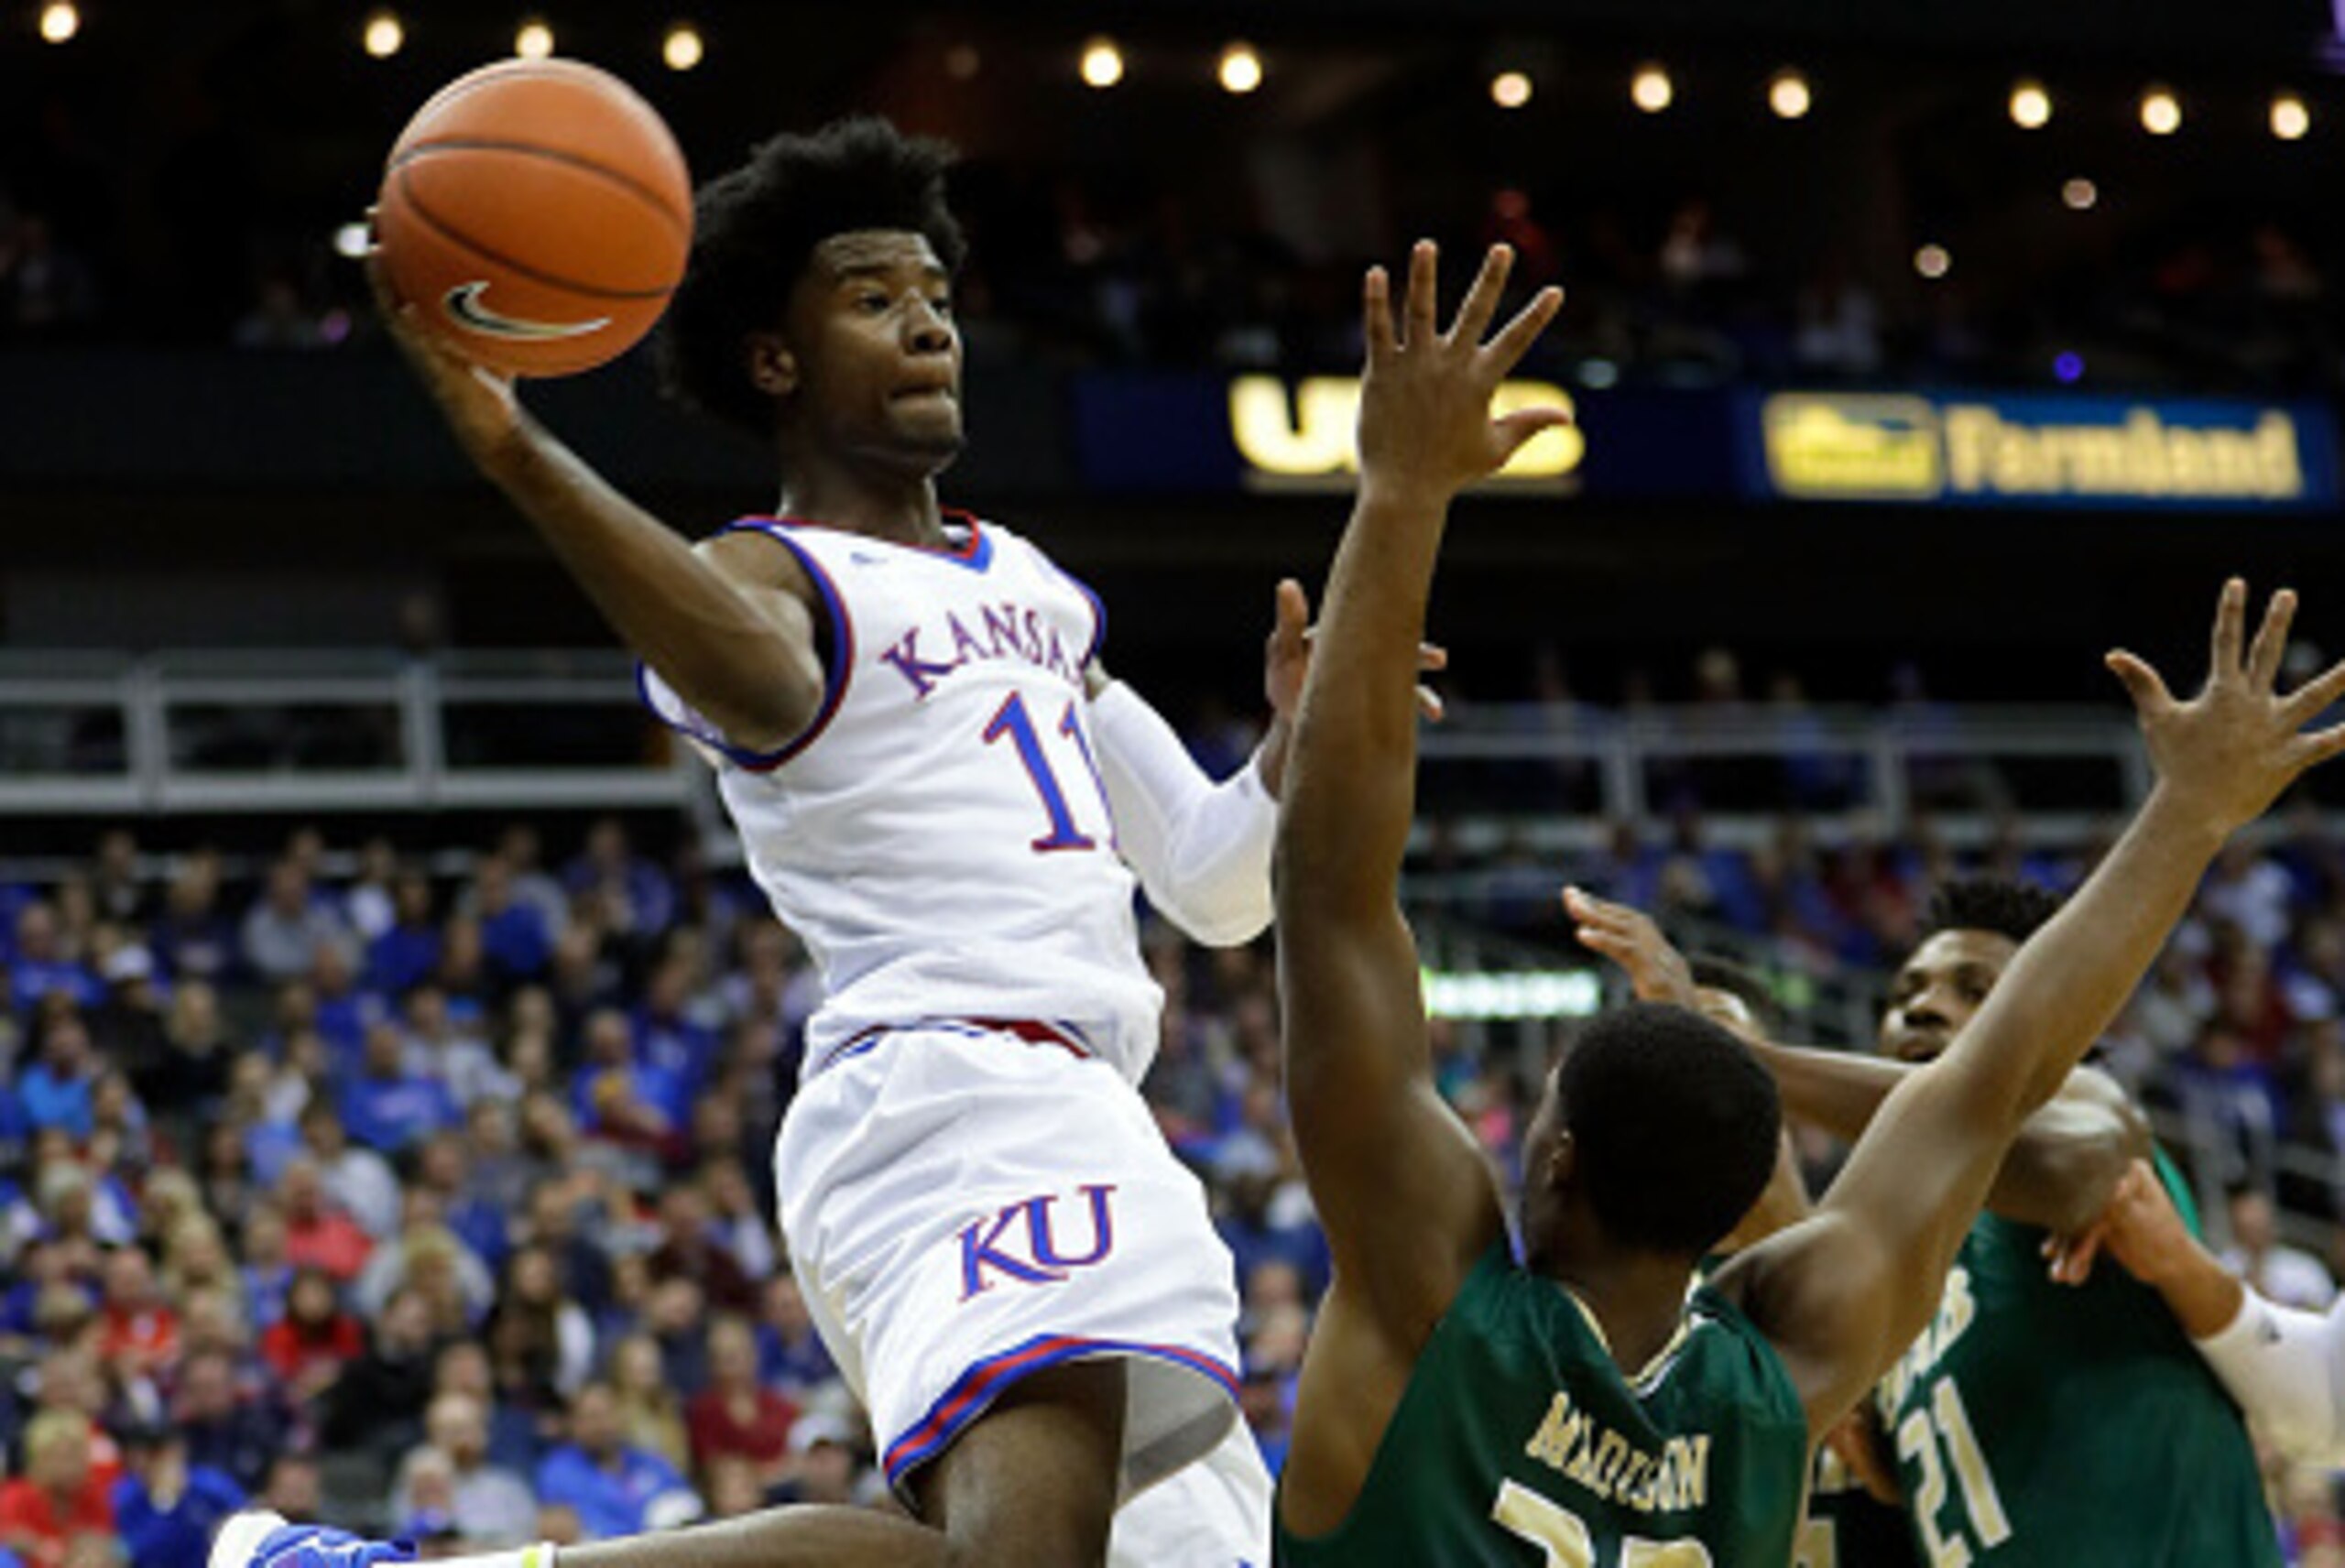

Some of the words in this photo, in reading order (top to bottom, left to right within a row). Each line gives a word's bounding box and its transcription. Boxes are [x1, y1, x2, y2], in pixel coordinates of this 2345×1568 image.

[878, 603, 1085, 699] KANSA
[956, 1184, 1118, 1303] KU
[1898, 1375, 2012, 1568] 21
